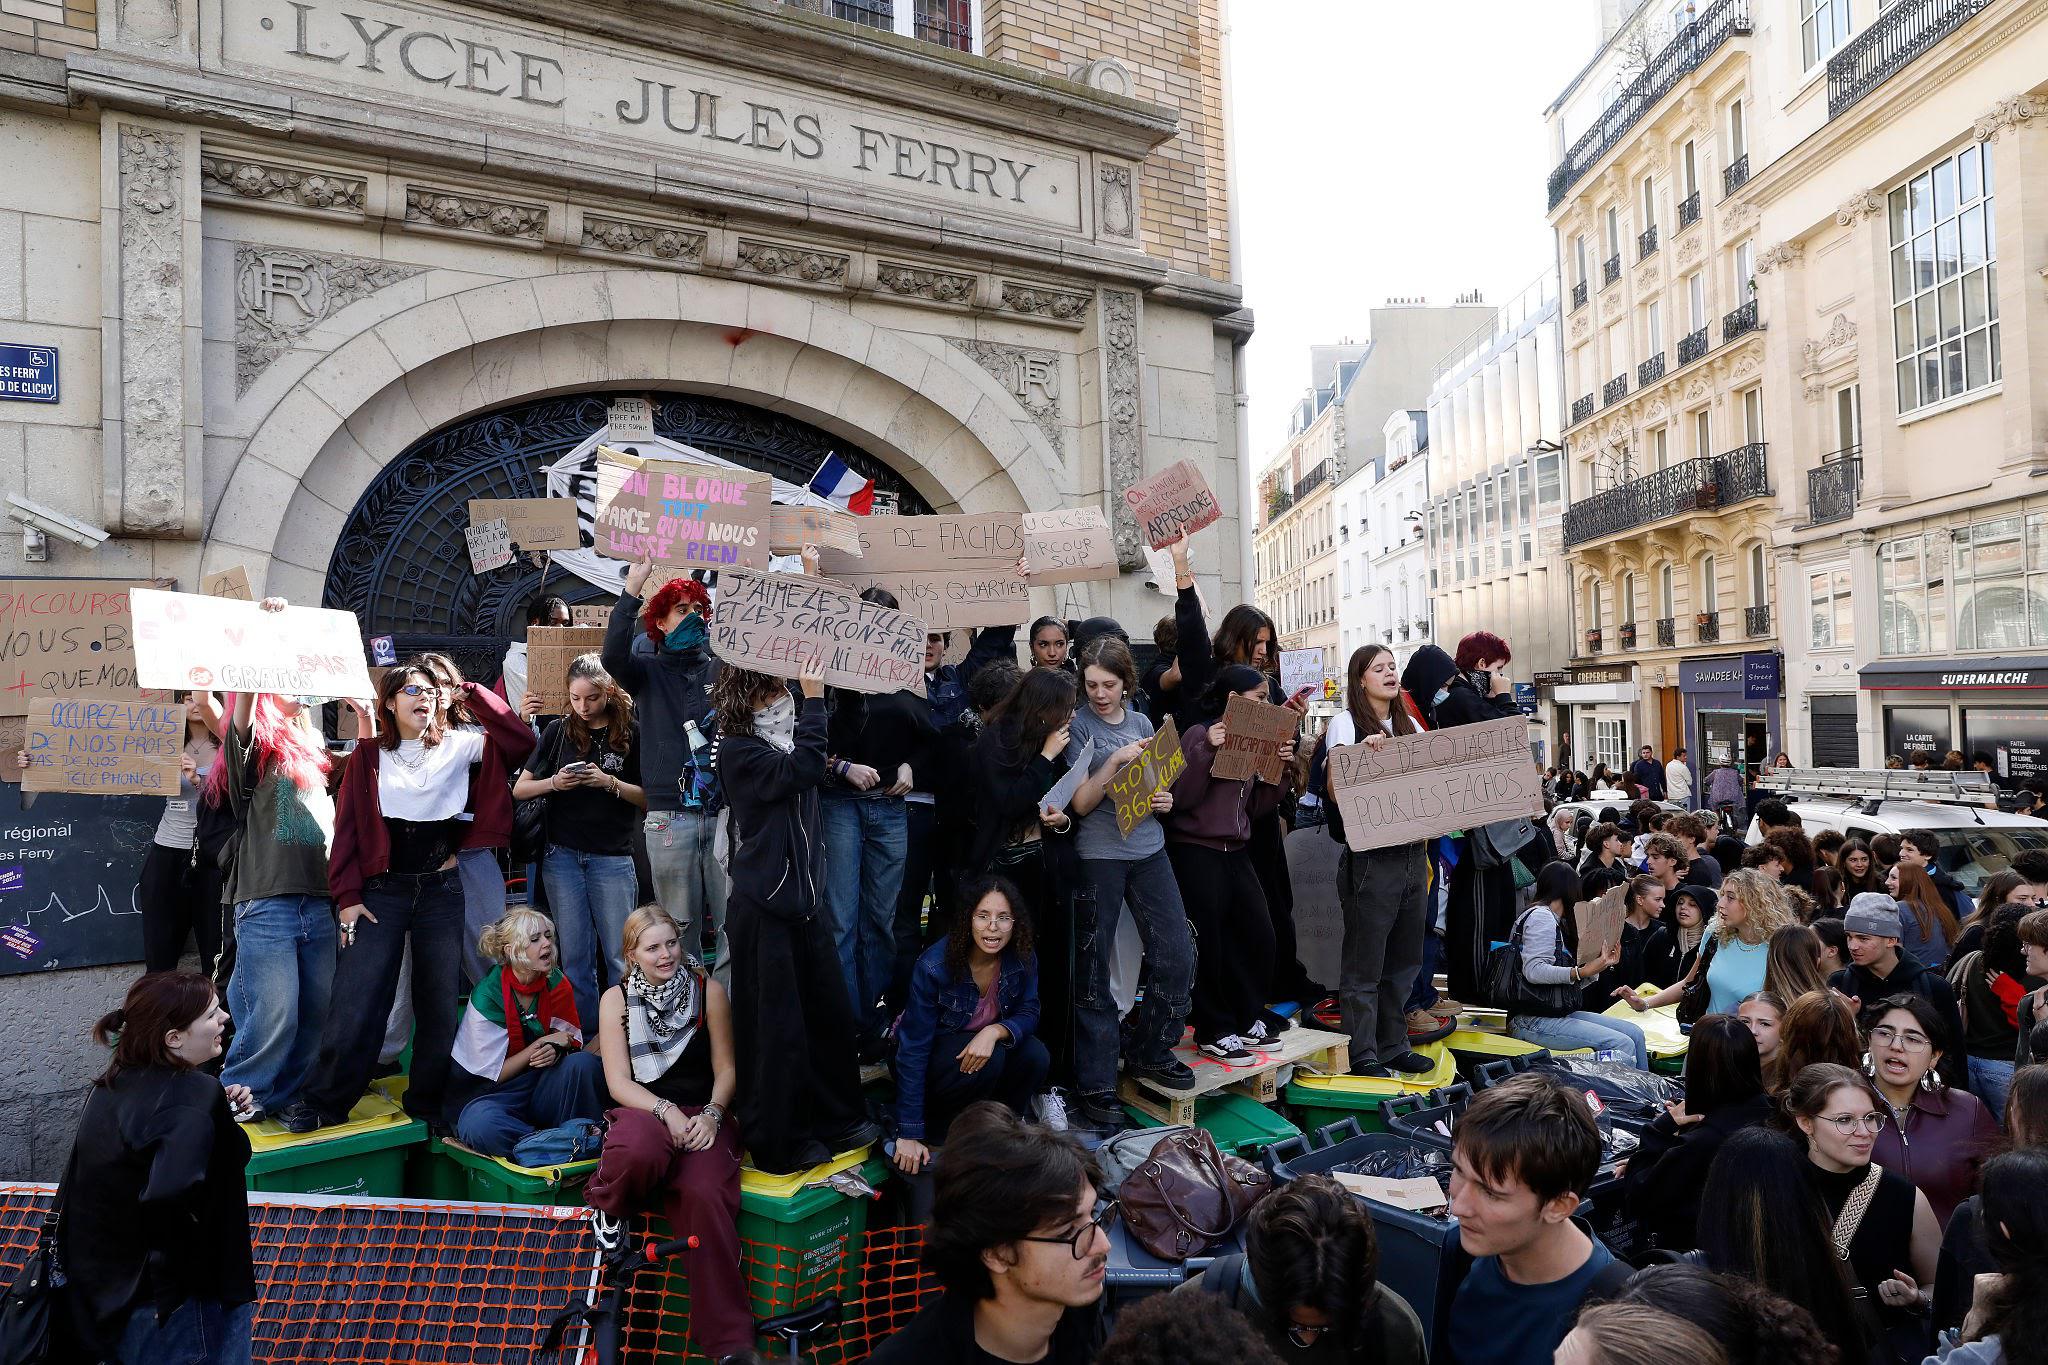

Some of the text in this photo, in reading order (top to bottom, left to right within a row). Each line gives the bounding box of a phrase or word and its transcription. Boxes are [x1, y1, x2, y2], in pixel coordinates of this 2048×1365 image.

[285, 1, 1037, 203] LYCEE JULES FERRY
[12, 367, 40, 379] FERRY
[8, 381, 20, 392] DE
[21, 382, 53, 395] CLICHY
[619, 470, 749, 507] ON BLOQUE
[1126, 490, 1148, 505] ON
[657, 500, 711, 521] TOUT
[1147, 489, 1212, 543] APPRENDRE
[494, 519, 507, 530] LA
[600, 505, 651, 535] PARCE
[656, 515, 706, 542] QU'ON
[707, 521, 759, 547] NOUS
[486, 533, 498, 544] LA
[609, 530, 738, 564] LAISSE RIEN
[893, 527, 927, 549] DE
[939, 522, 1025, 554] FACHOS
[473, 544, 506, 559] ET LA
[1051, 551, 1089, 568] SUP
[723, 573, 804, 609] J'AIME
[801, 586, 851, 615] LES
[899, 578, 939, 602] NOS
[945, 577, 1029, 601] QUARTIERS
[715, 600, 745, 626] ET
[739, 602, 786, 629] LES
[792, 611, 891, 645] GARÇONS
[858, 605, 925, 643] FILLES
[718, 626, 755, 655] PAS
[855, 652, 924, 689] MACRON
[1750, 662, 1771, 670] Thai
[1695, 670, 1731, 683] SAWADEE
[1748, 673, 1773, 681] Street
[1941, 672, 2029, 685] SUPERMARCHE
[1751, 684, 1771, 692] Food
[52, 702, 178, 735] OCCUPEZ-VOUS
[31, 731, 177, 755] DE NOS PROFS
[1903, 741, 1937, 751] DE FIDÉLITÉ
[1906, 734, 1933, 743] LA CARTE
[27, 754, 120, 768] PAS DE NOS
[1339, 725, 1530, 786] PAS DE QUARTIER
[1354, 791, 1411, 838] POUR
[1409, 784, 1444, 820] LES
[4, 823, 72, 842] régional
[0, 848, 55, 860] es Ferry
[1183, 1105, 1192, 1113] 66
